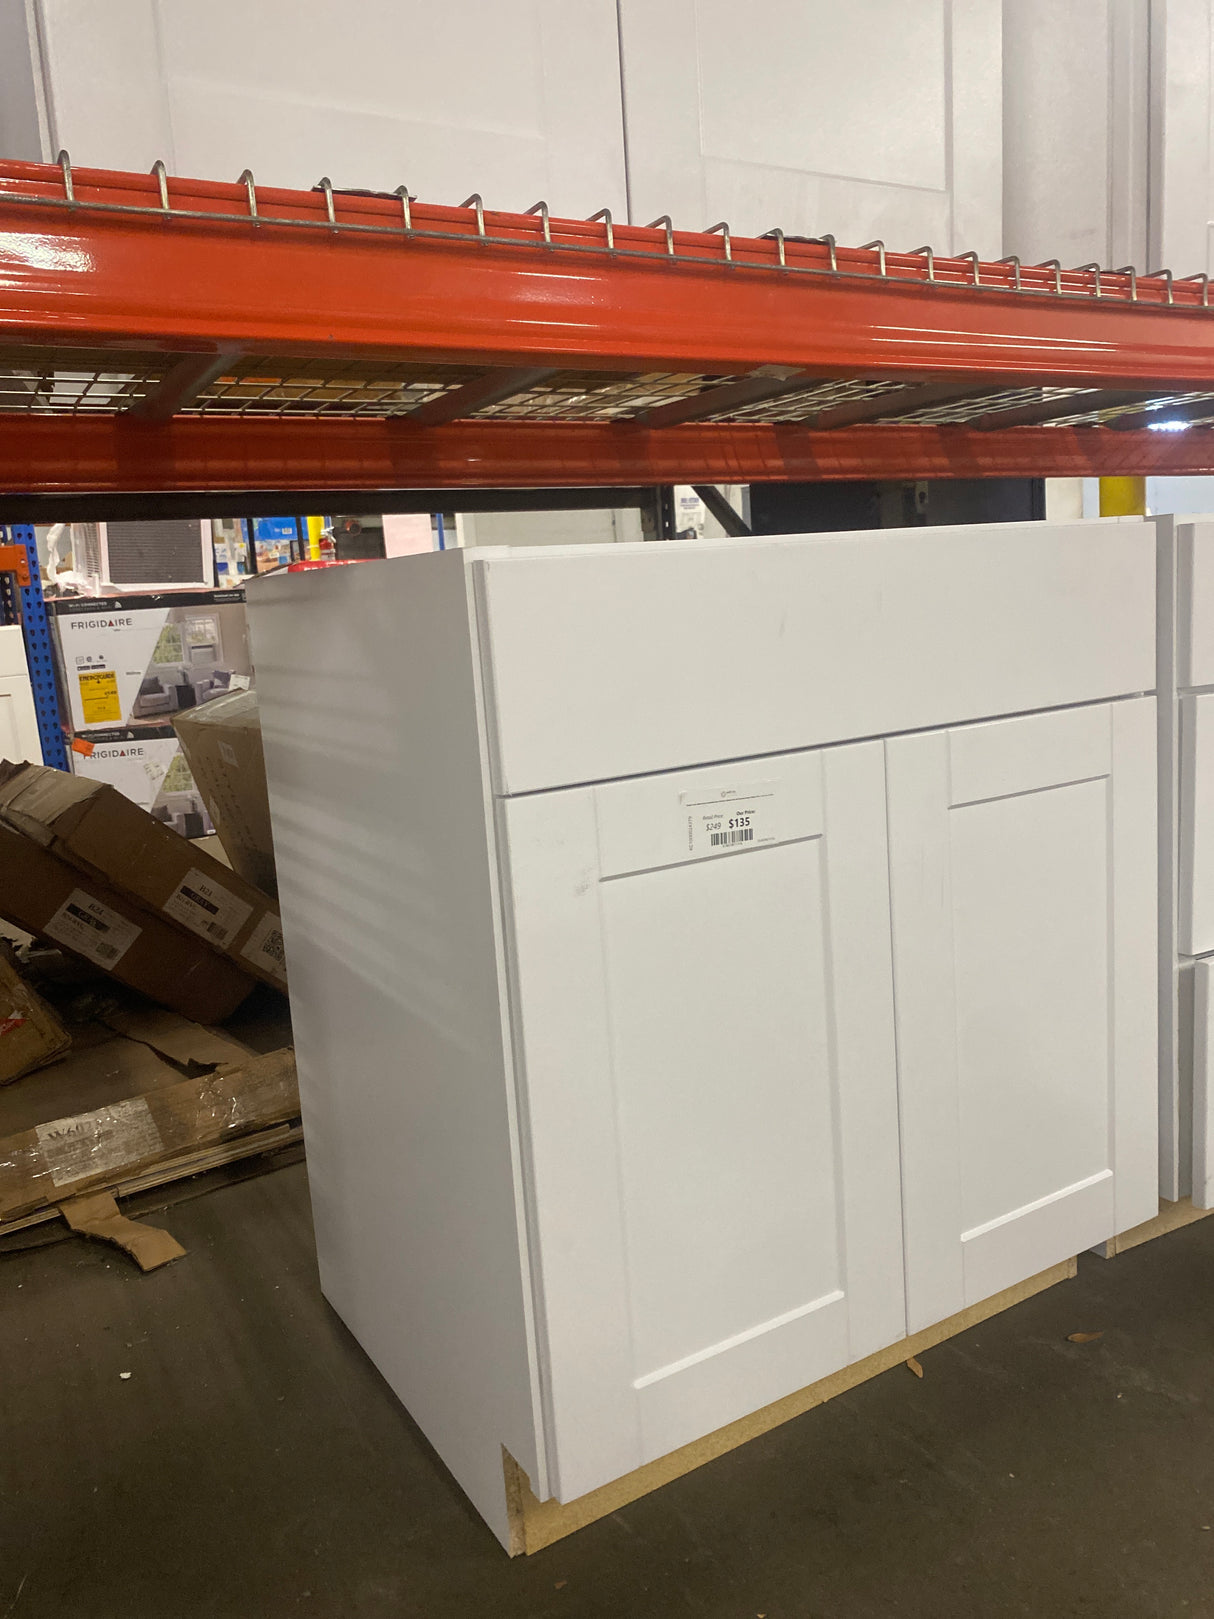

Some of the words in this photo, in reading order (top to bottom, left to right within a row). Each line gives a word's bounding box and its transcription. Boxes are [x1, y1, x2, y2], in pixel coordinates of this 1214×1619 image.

[71, 618, 133, 629] FRIGIDAIRE
[706, 822, 722, 831] $249
[729, 817, 750, 829] $135
